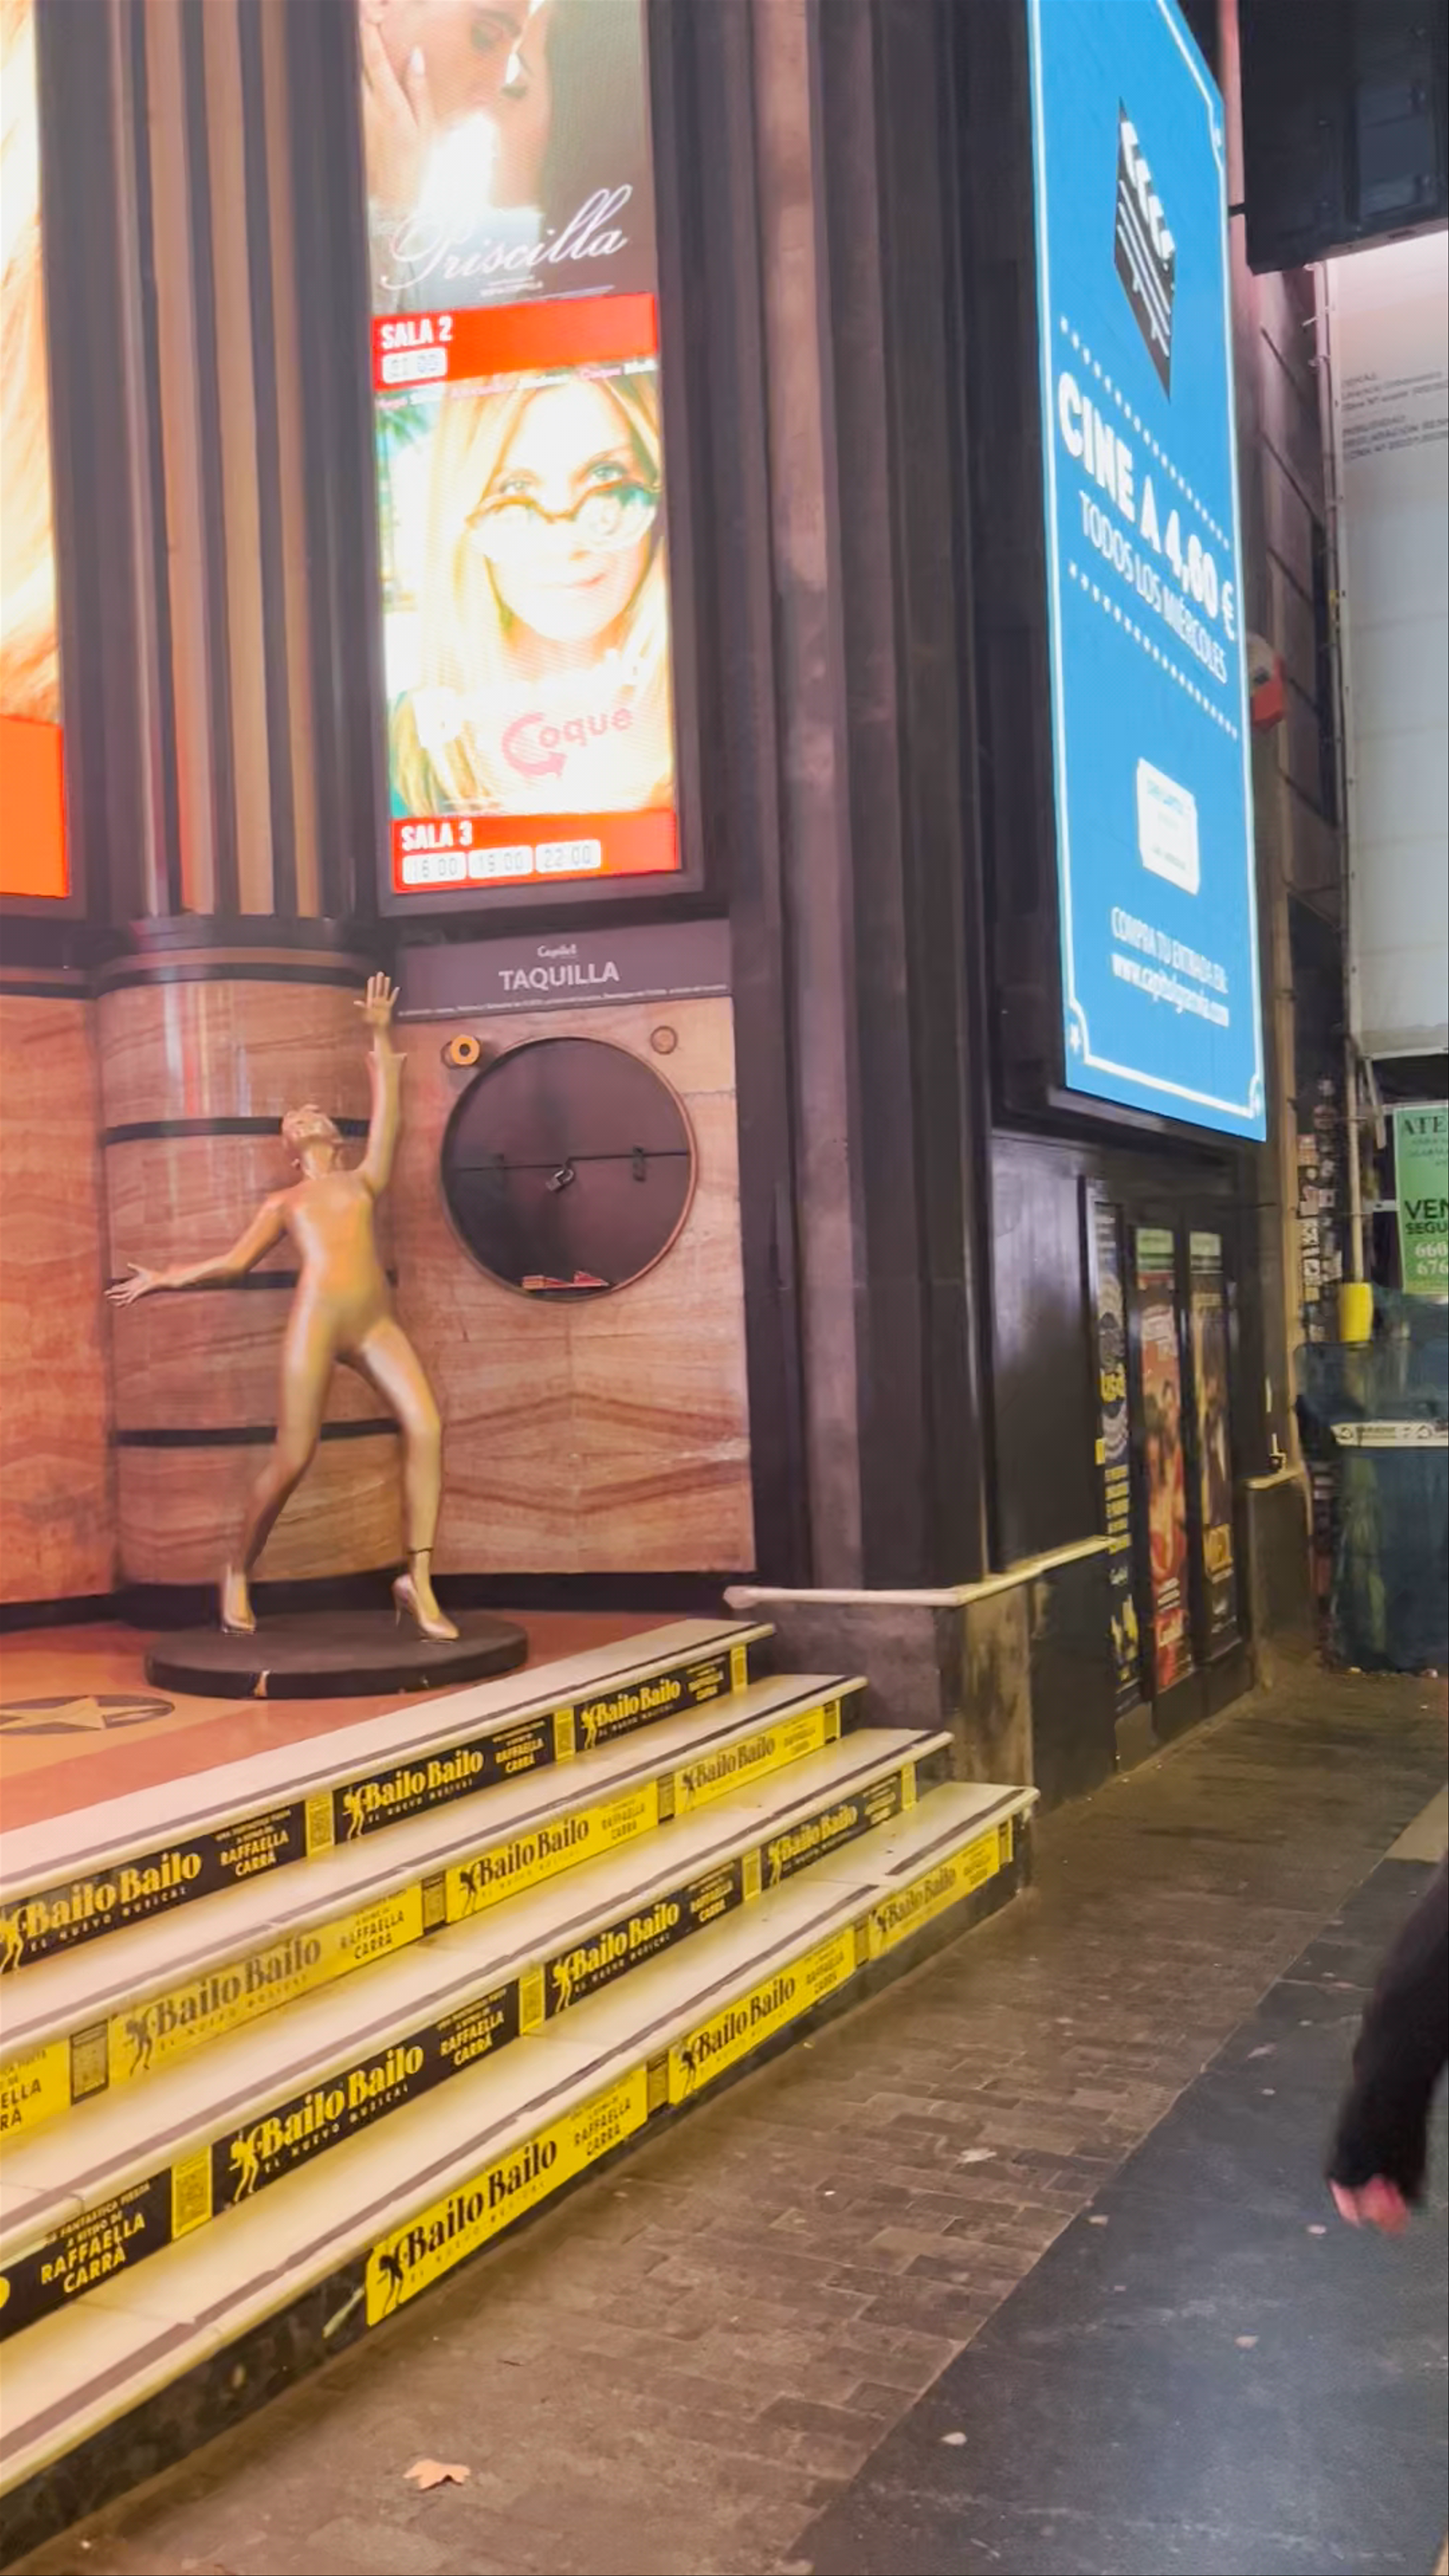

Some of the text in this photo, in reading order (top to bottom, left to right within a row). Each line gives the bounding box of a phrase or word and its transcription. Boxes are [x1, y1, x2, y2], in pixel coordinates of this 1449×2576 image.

[380, 183, 633, 290] Priscilla
[381, 316, 453, 349] SALA 2
[1058, 371, 1135, 523] CINE
[1140, 474, 1162, 554] A
[1222, 581, 1234, 641] €
[1080, 489, 1134, 583] TODOS
[1135, 552, 1162, 613] LOS
[501, 708, 633, 780] Coque
[401, 821, 473, 851] SALA 3
[499, 961, 620, 991] TAQUILLA
[221, 1830, 289, 1866] RAFFAELLA
[25, 1852, 202, 1938] Bailo Bailo
[153, 1938, 322, 2035] Bailo Bailo
[441, 2010, 505, 2056] RAFFAELLA
[262, 2046, 424, 2160] Bailo Bailo
[349, 2084, 408, 2124] MUSICAL
[405, 2140, 558, 2267] Bailo Bailo
[41, 2213, 145, 2285] RAFFAELLA
